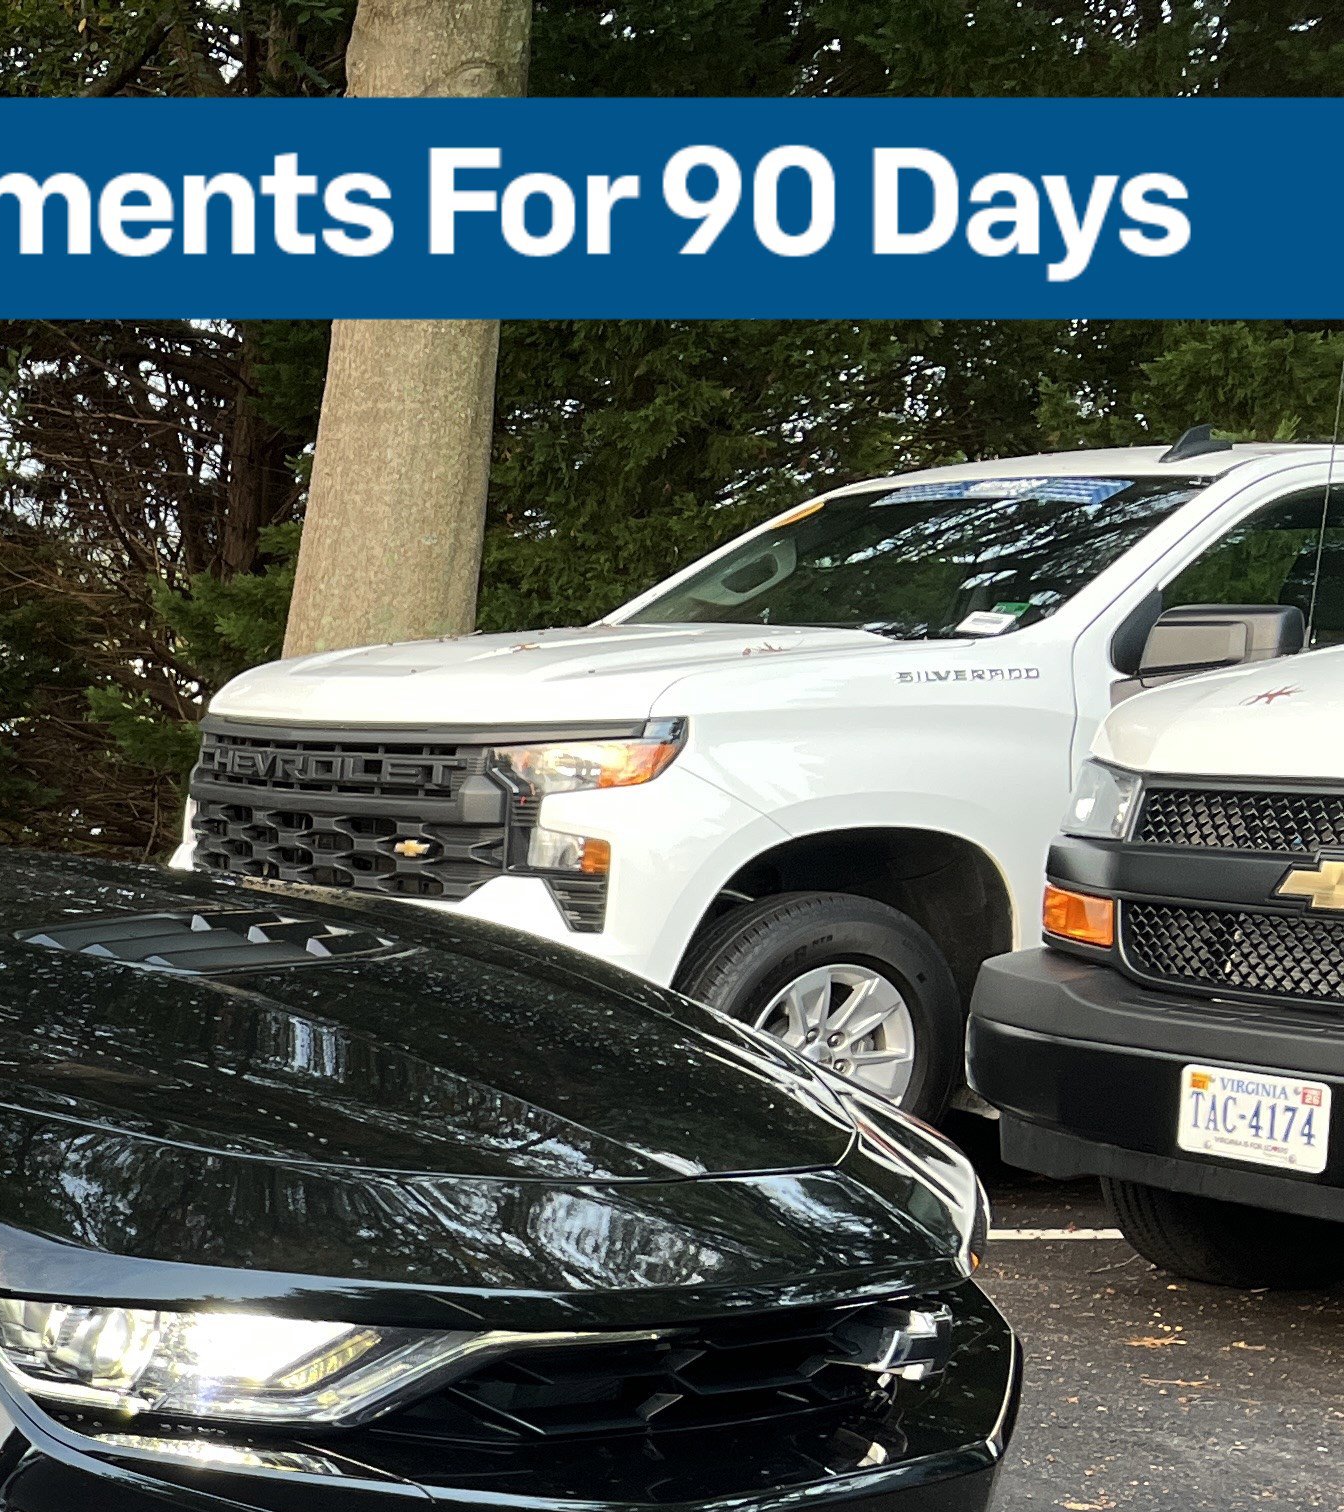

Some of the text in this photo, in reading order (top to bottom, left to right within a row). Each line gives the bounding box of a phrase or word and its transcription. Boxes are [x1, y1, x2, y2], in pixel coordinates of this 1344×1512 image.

[894, 667, 1041, 684] SILVERADO
[202, 747, 458, 786] CHEVROLET
[1220, 1076, 1289, 1101] VIRGINIA
[1190, 1090, 1317, 1148] TAC-4174
